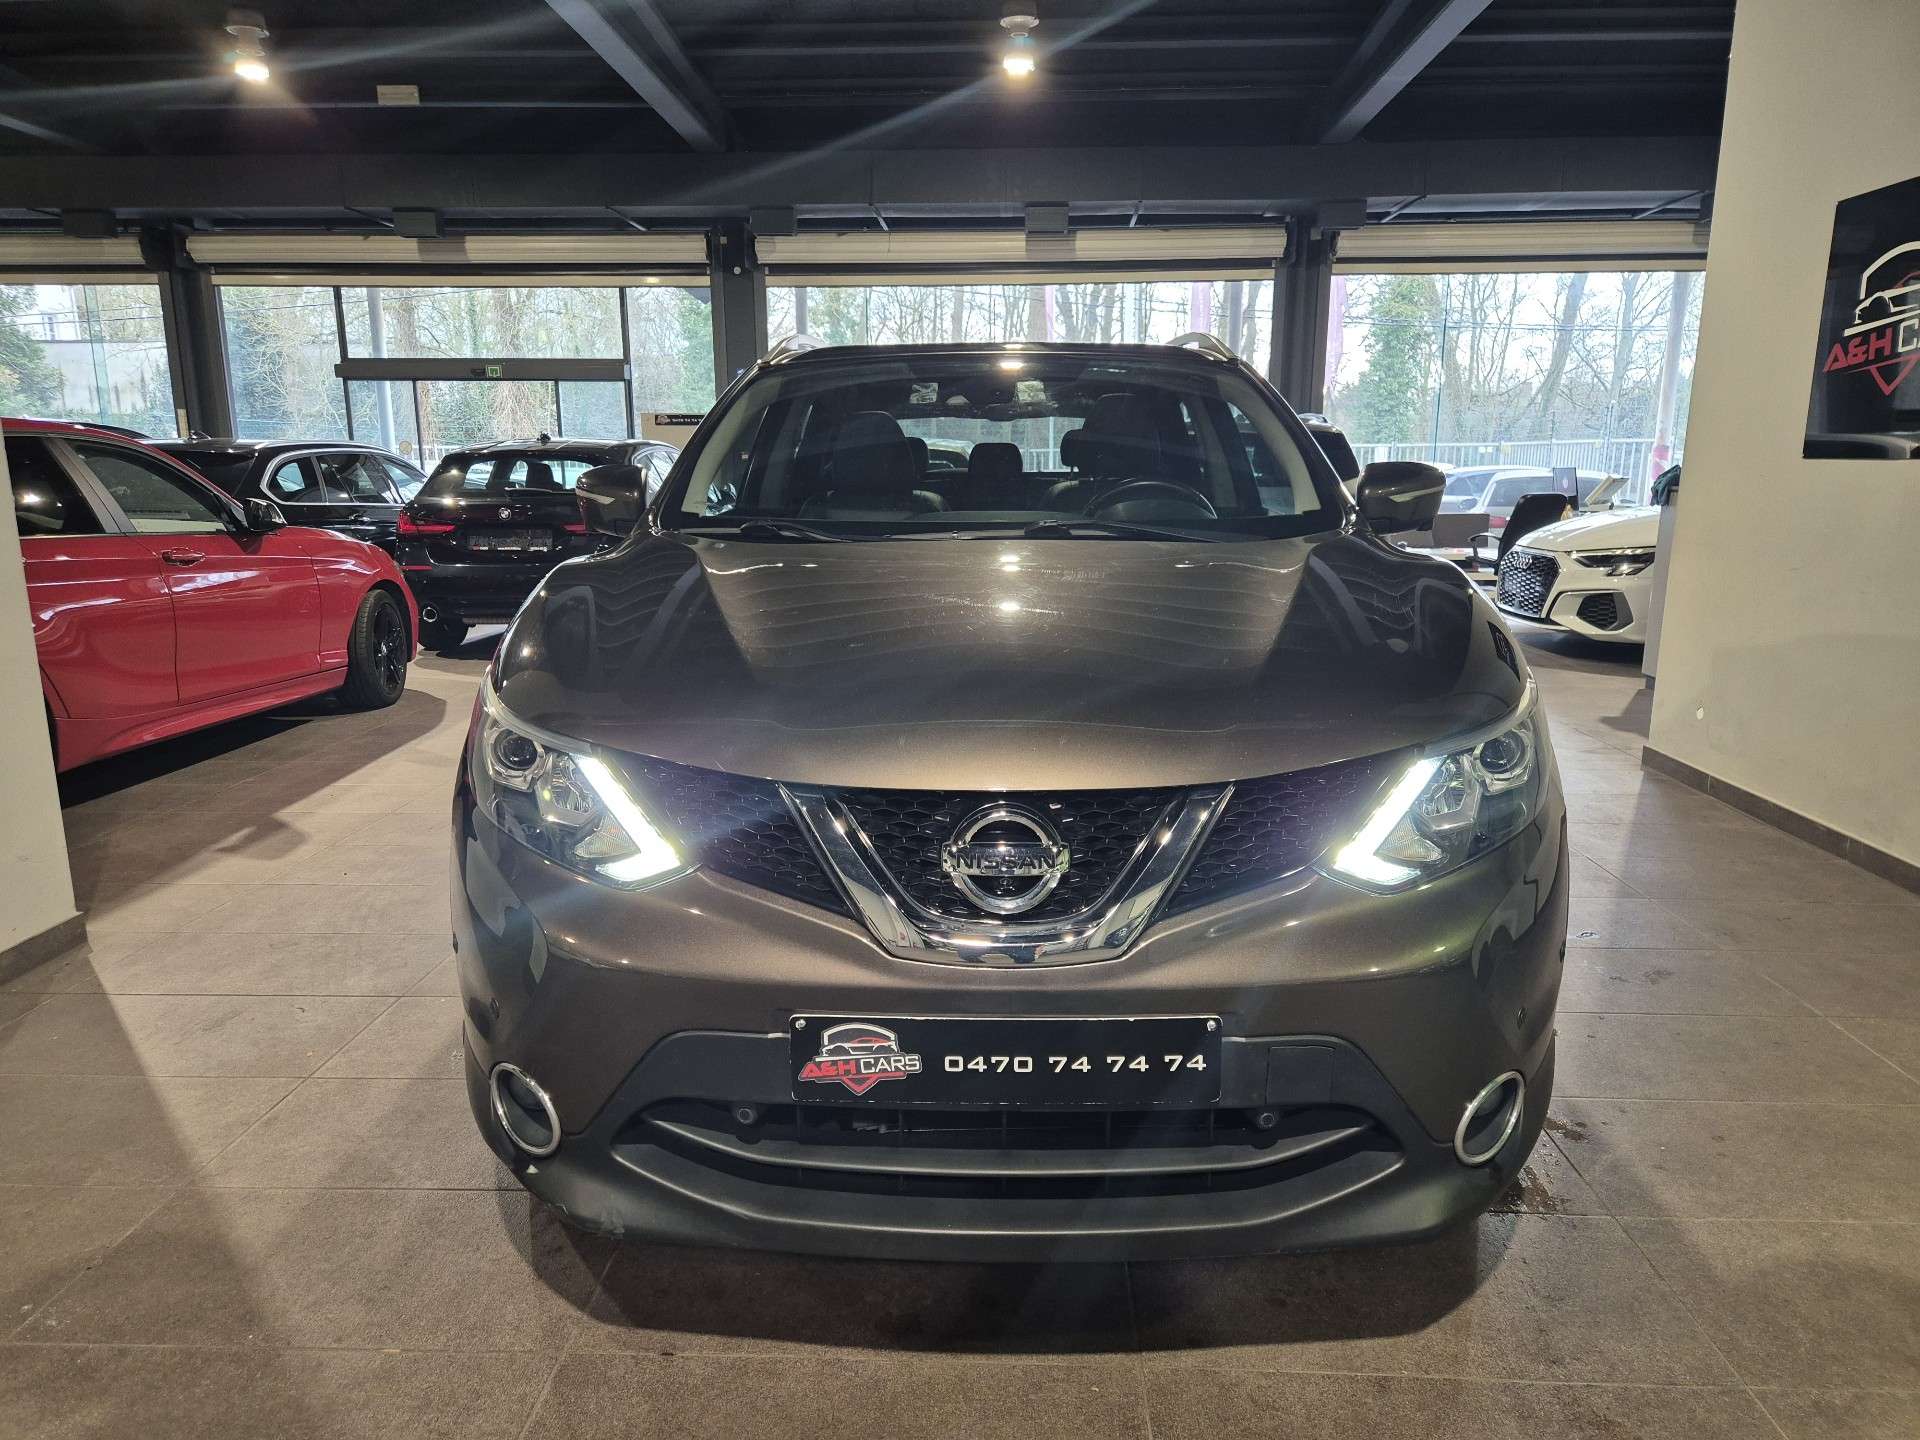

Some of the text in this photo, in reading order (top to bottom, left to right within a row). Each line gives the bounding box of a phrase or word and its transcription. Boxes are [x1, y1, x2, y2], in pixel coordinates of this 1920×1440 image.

[1823, 318, 1920, 373] A&H C
[956, 853, 1057, 870] NISSAN
[801, 1056, 919, 1077] A&H CARS
[944, 1054, 1207, 1073] 0470 74 74 74
